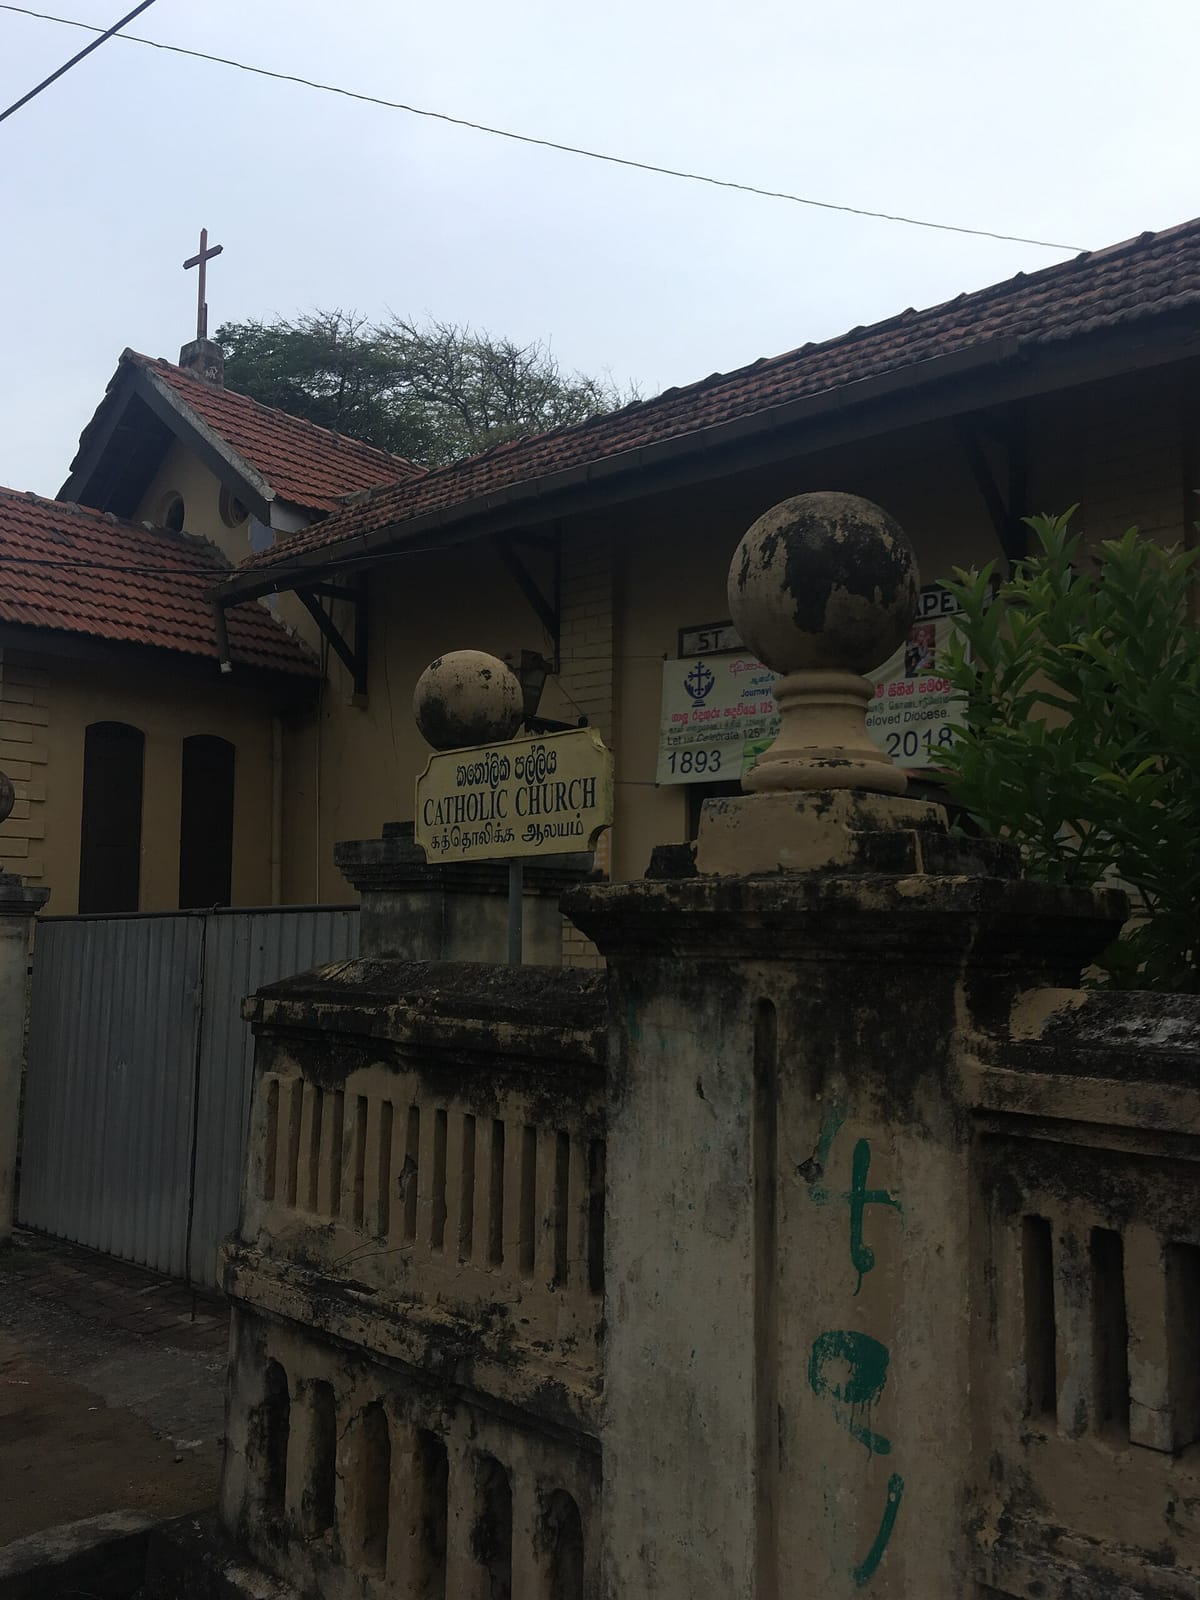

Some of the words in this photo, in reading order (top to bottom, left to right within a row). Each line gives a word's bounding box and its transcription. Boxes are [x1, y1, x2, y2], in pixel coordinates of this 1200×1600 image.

[914, 591, 962, 616] PE
[697, 629, 724, 651] ST
[667, 735, 682, 746] Let
[904, 708, 950, 723] Diocese.
[886, 727, 953, 758] 2018
[668, 749, 721, 774] 1893
[423, 788, 509, 827] CATHOLIC
[515, 776, 597, 817] CHURCH
[521, 812, 584, 847] ஆலயம்
